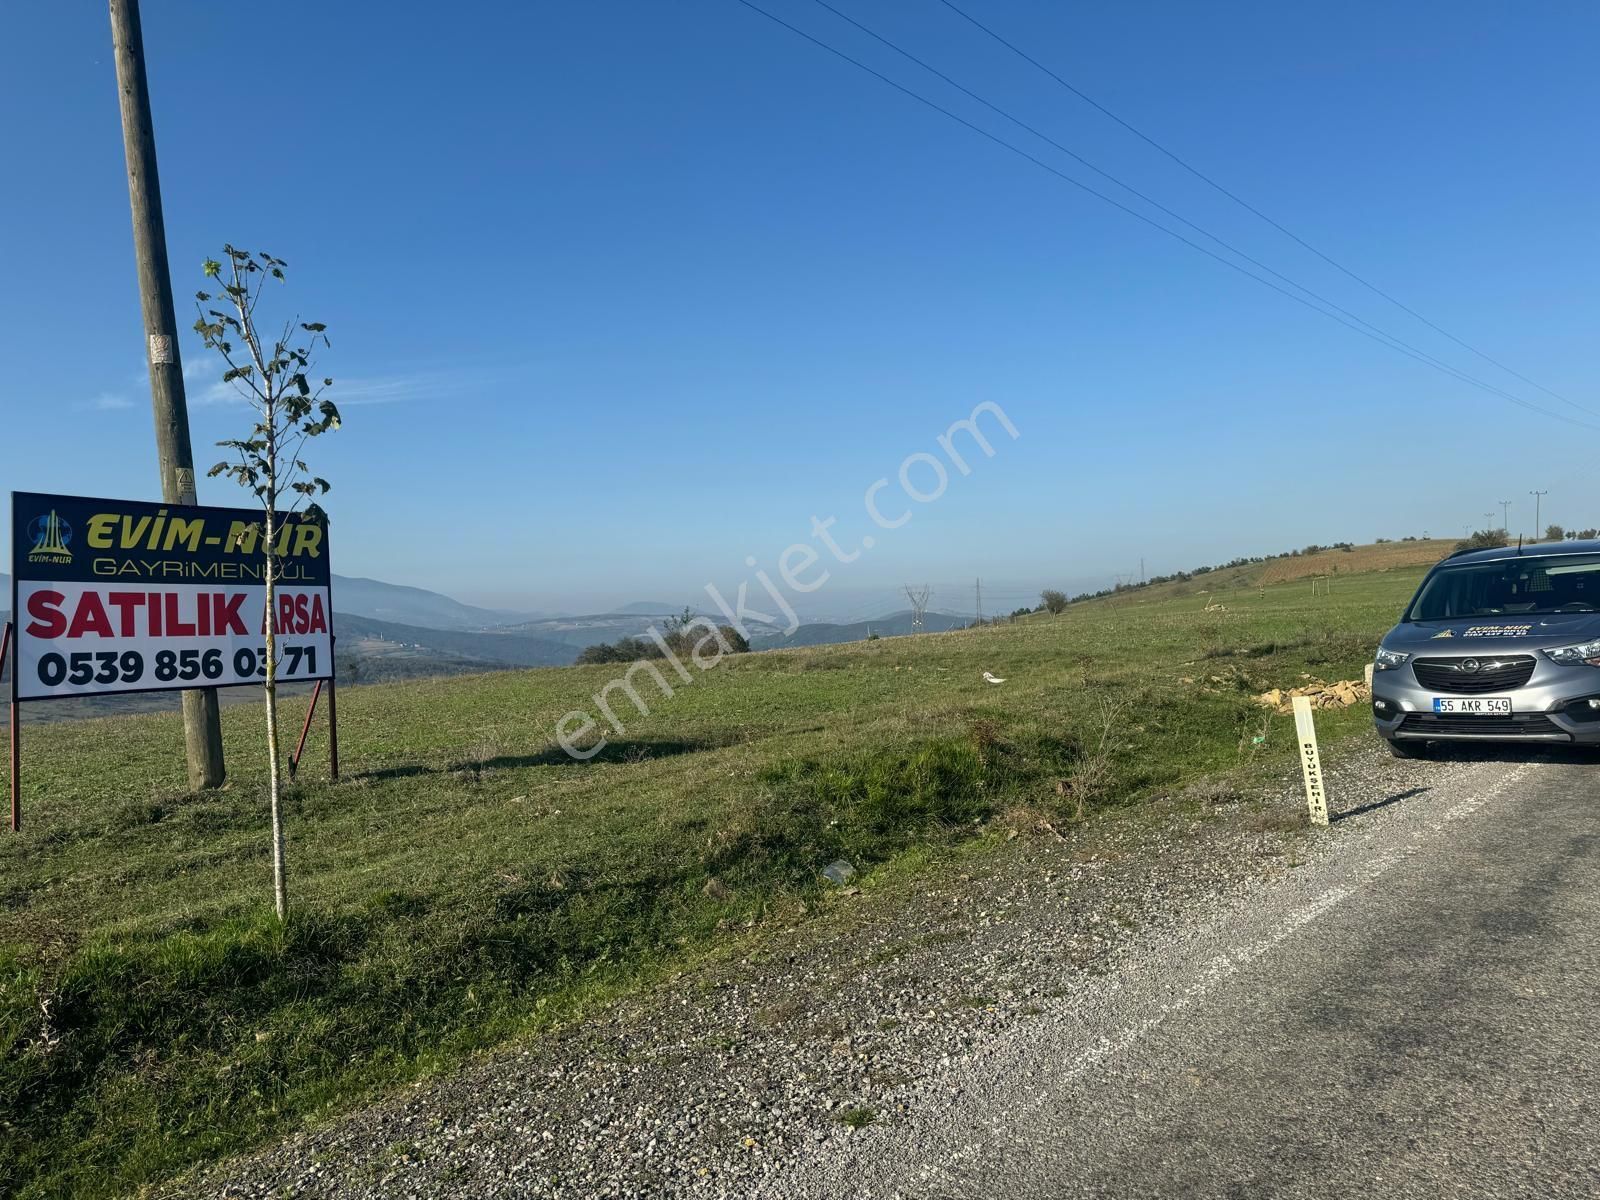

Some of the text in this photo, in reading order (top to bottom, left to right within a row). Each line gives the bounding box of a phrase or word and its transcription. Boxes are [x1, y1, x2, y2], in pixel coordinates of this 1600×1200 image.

[26, 590, 328, 638] SATILIK ARSA
[37, 650, 144, 686] 0539
[155, 649, 223, 682] 856
[284, 645, 317, 675] 71
[1440, 700, 1509, 712] 55 AKR 549
